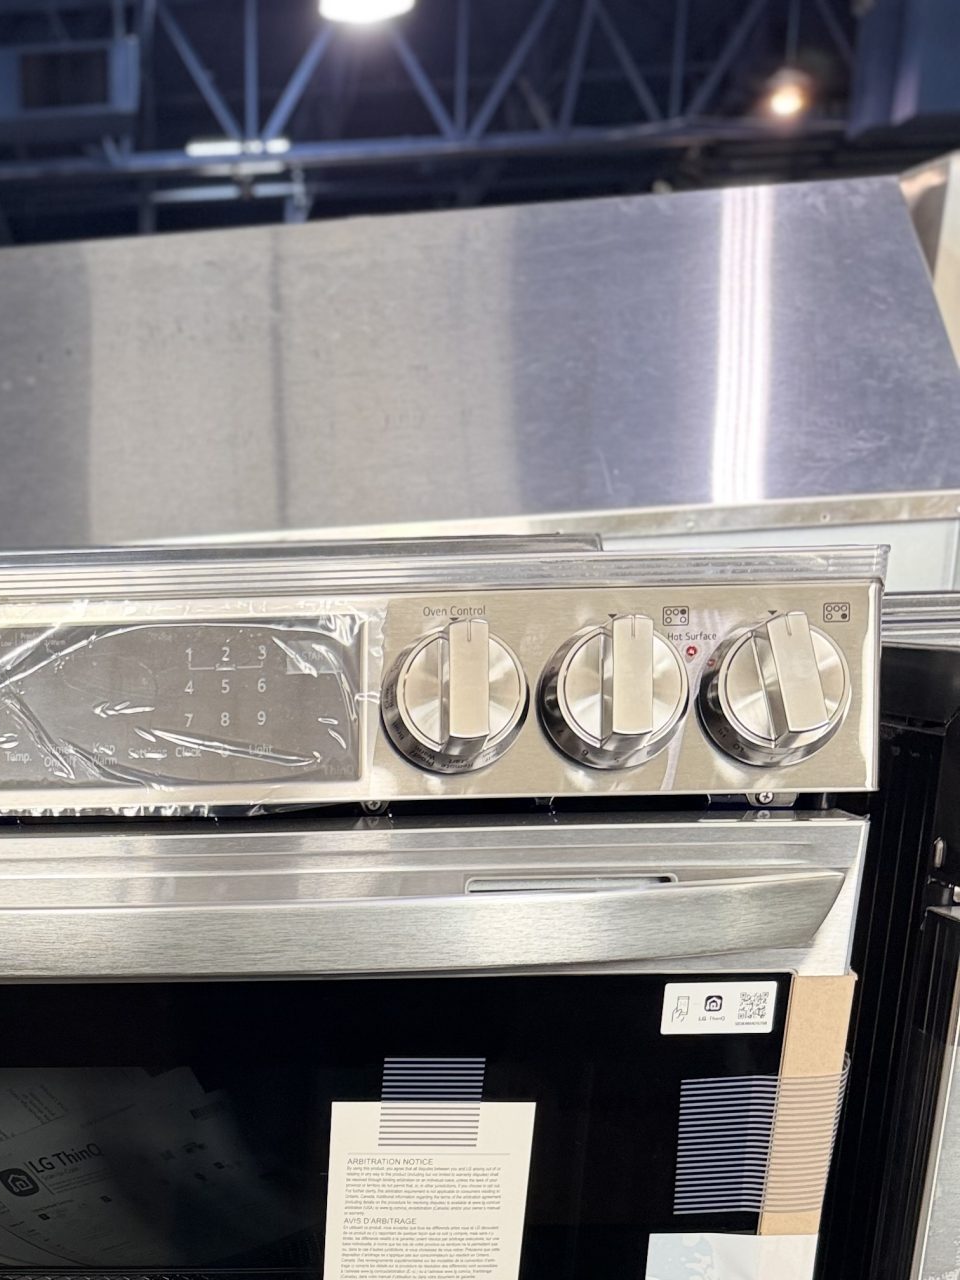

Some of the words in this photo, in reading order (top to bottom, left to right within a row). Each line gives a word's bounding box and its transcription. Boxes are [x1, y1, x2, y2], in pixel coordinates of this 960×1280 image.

[423, 607, 447, 617] Oven
[449, 605, 486, 616] Control
[667, 631, 682, 640] Hot
[684, 630, 717, 641] Surface
[185, 648, 193, 662] 1
[222, 647, 230, 662] 2
[257, 645, 266, 660] 3
[184, 680, 194, 695] 4
[221, 679, 230, 694] 5
[257, 678, 266, 693] 6
[185, 713, 194, 728] 7
[221, 712, 230, 727] 8
[257, 711, 266, 726] 9
[248, 744, 273, 757] Light
[6, 752, 32, 765] Temp.
[27, 1156, 56, 1174] LG
[53, 1142, 105, 1168] ThinQ
[363, 1217, 417, 1225] D'ARBITRAGE
